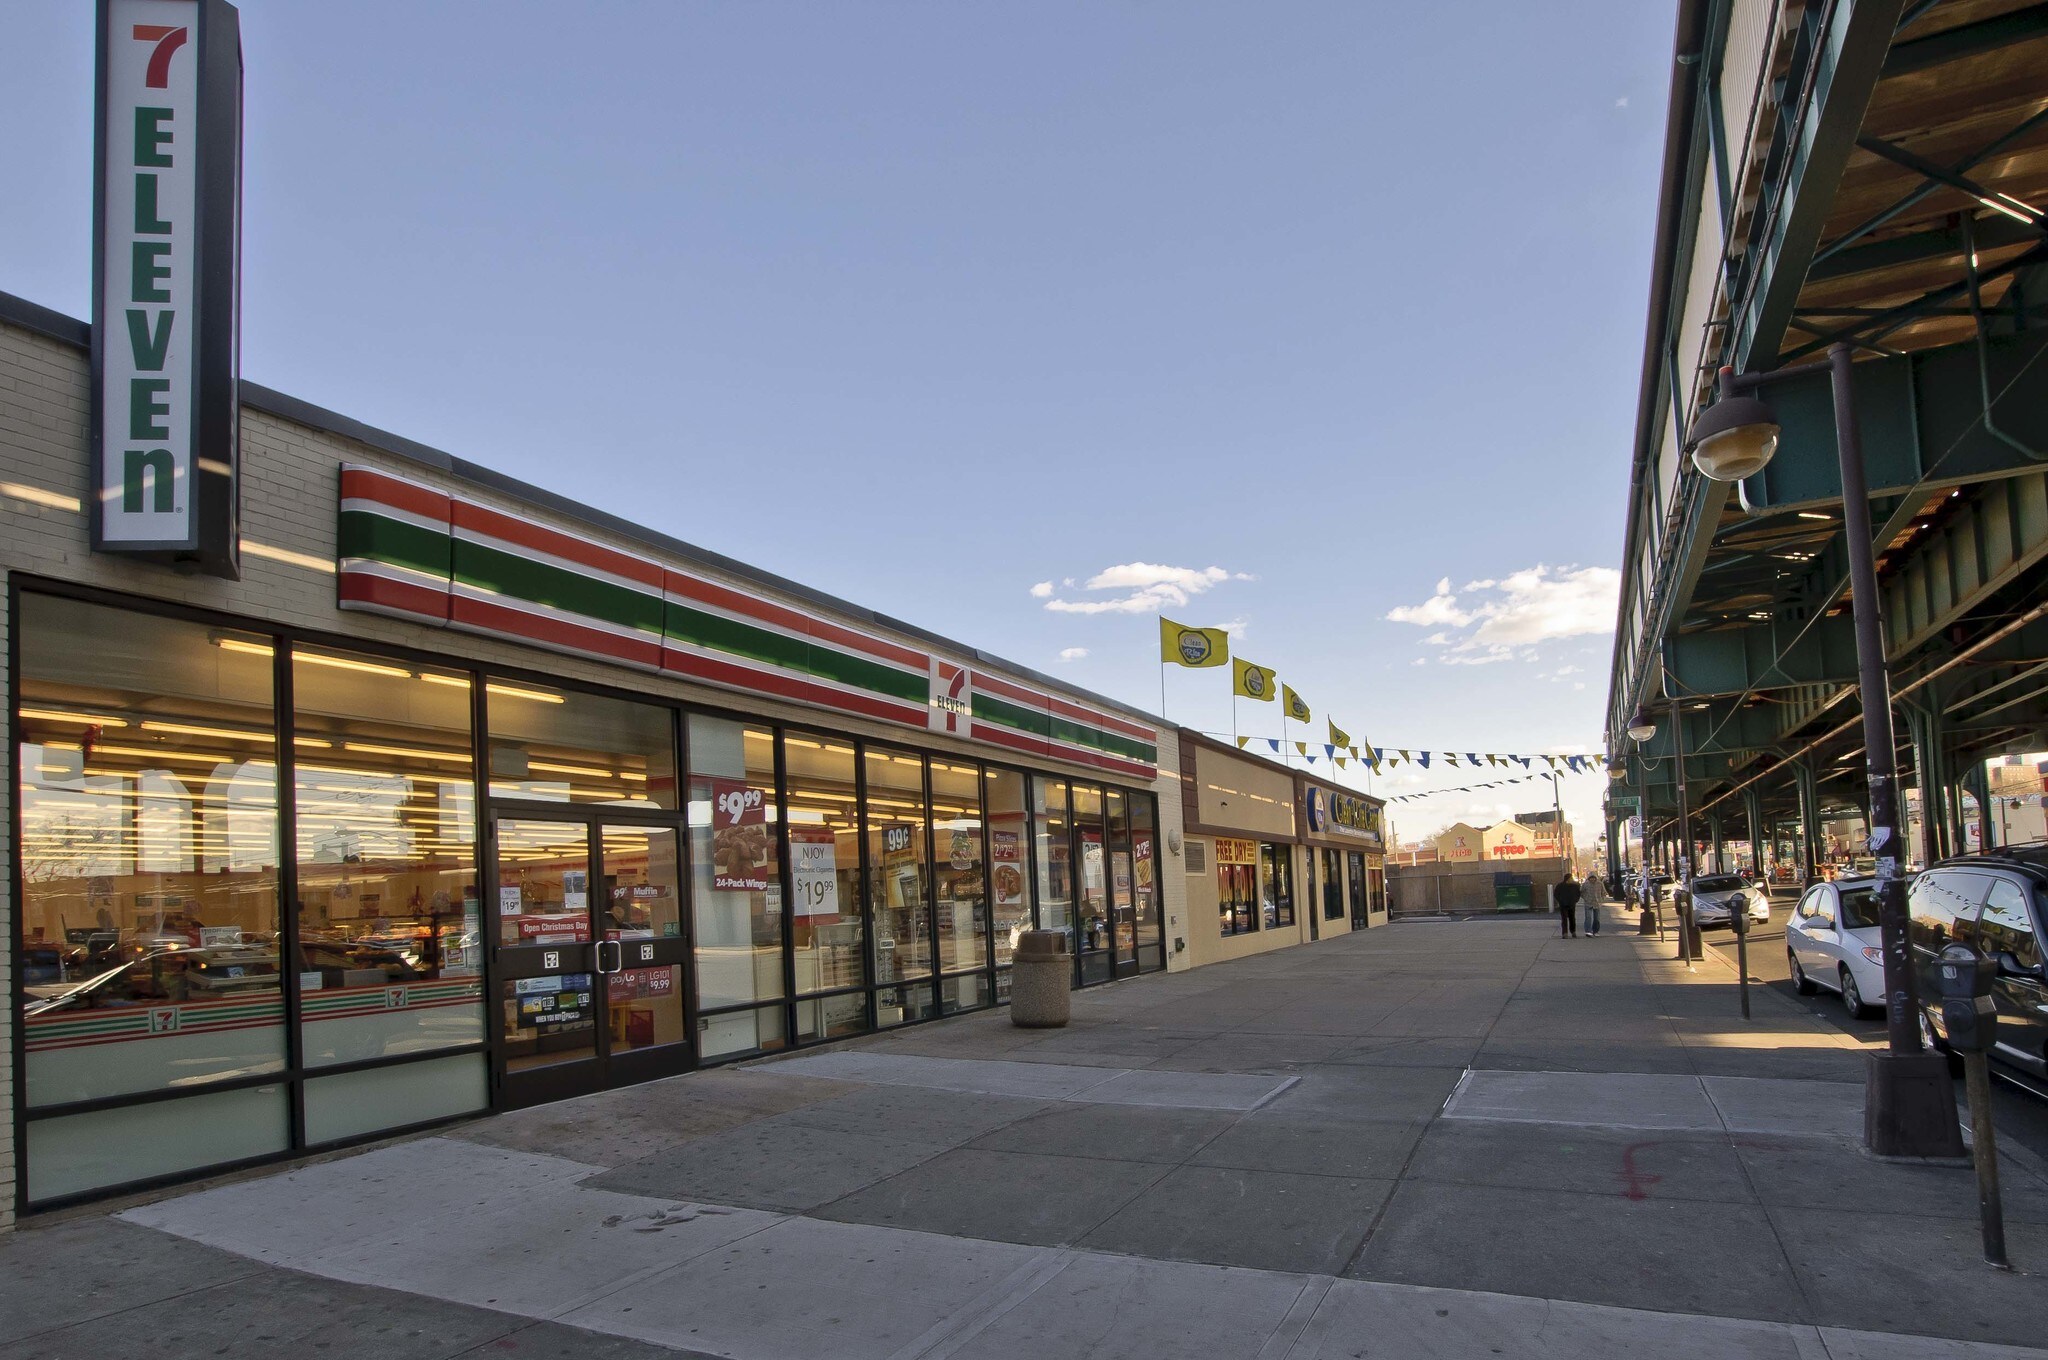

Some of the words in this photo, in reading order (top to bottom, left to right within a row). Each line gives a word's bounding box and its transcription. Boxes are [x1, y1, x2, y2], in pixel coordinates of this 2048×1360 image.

[132, 24, 187, 89] 7
[938, 660, 965, 733] 7
[802, 847, 825, 860] NJOY
[1216, 839, 1233, 862] FREE
[1493, 845, 1526, 856] PETCO
[633, 886, 658, 896] Muffin
[716, 878, 745, 888] 24-Pack
[745, 879, 768, 891] Wings
[523, 923, 540, 934] Open
[541, 922, 574, 932] Christmas
[575, 921, 588, 931] Day
[650, 979, 670, 990] $9.99
